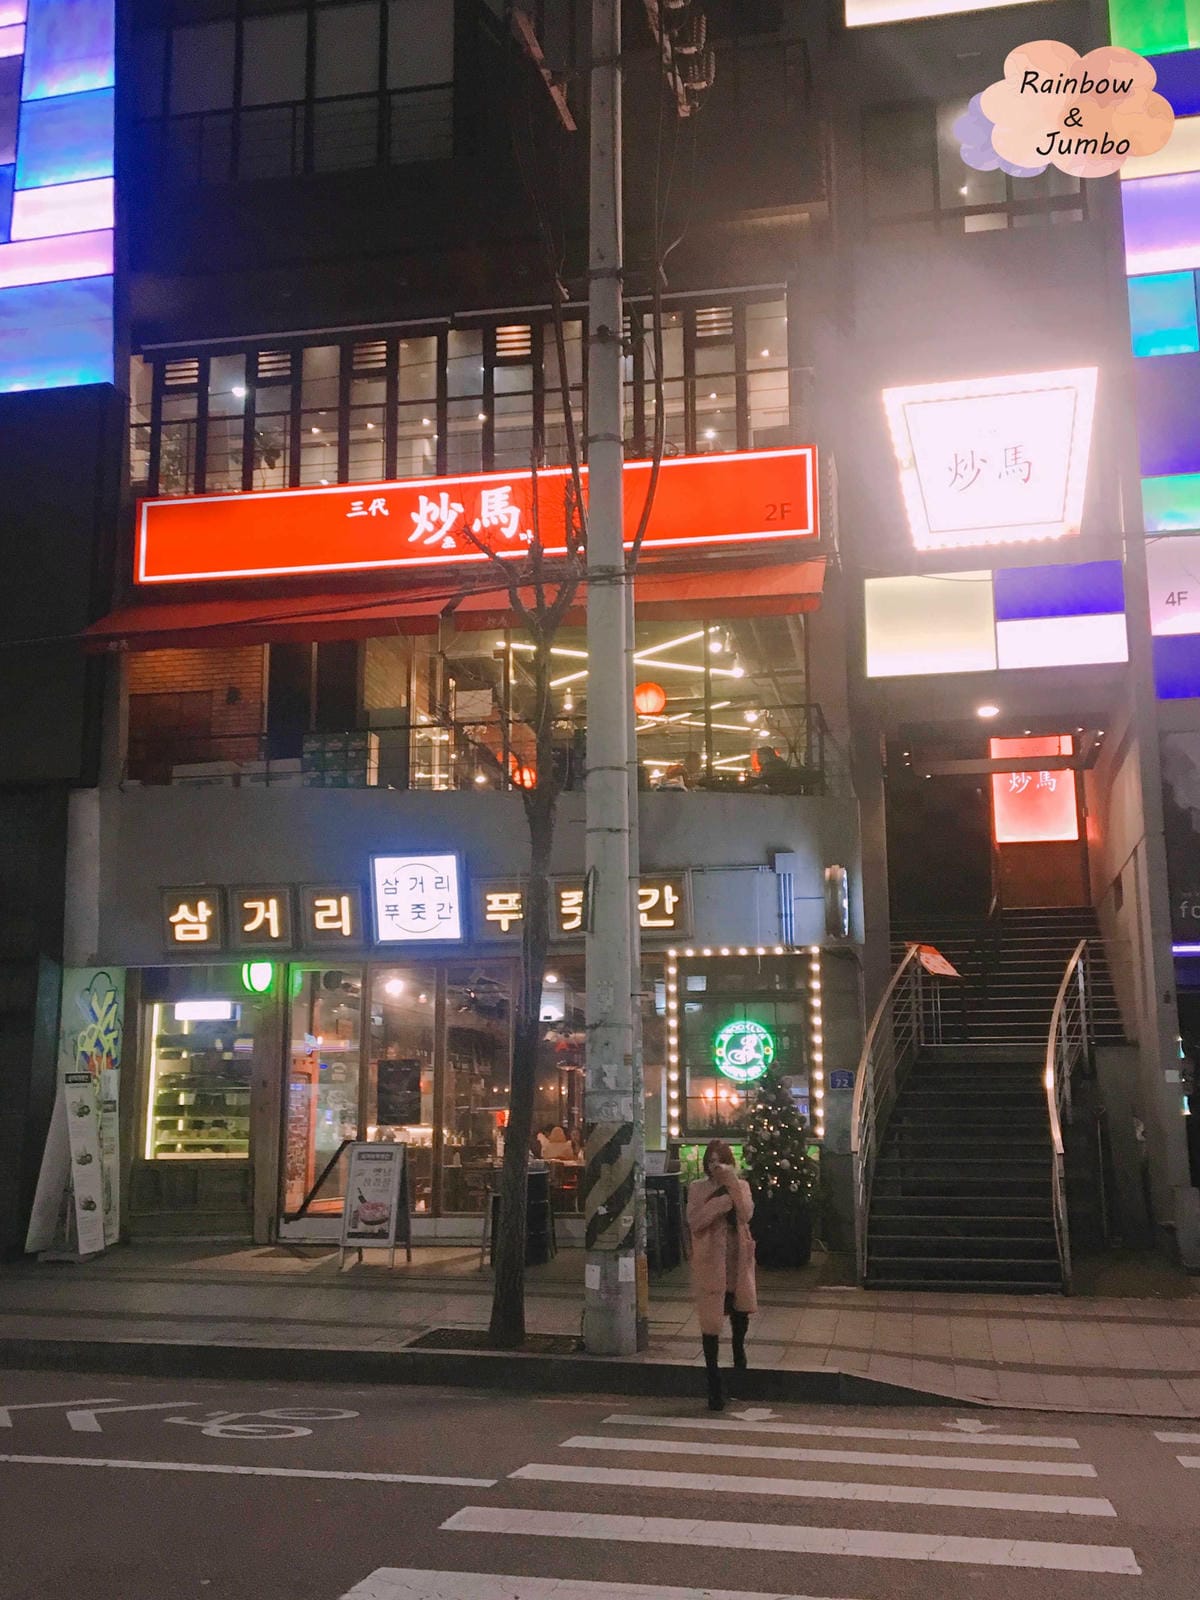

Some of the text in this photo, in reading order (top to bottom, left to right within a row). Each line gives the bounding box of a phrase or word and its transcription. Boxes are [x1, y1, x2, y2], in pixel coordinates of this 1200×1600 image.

[947, 444, 1033, 493] 炒馬
[346, 485, 521, 545] 三代 炒馬
[764, 502, 793, 521] 2F
[1165, 591, 1188, 606] 4F
[1008, 770, 1058, 794] 炒馬
[382, 874, 450, 896] 삼거리
[168, 895, 351, 942] 삼거리
[384, 901, 454, 921] 푸줏간
